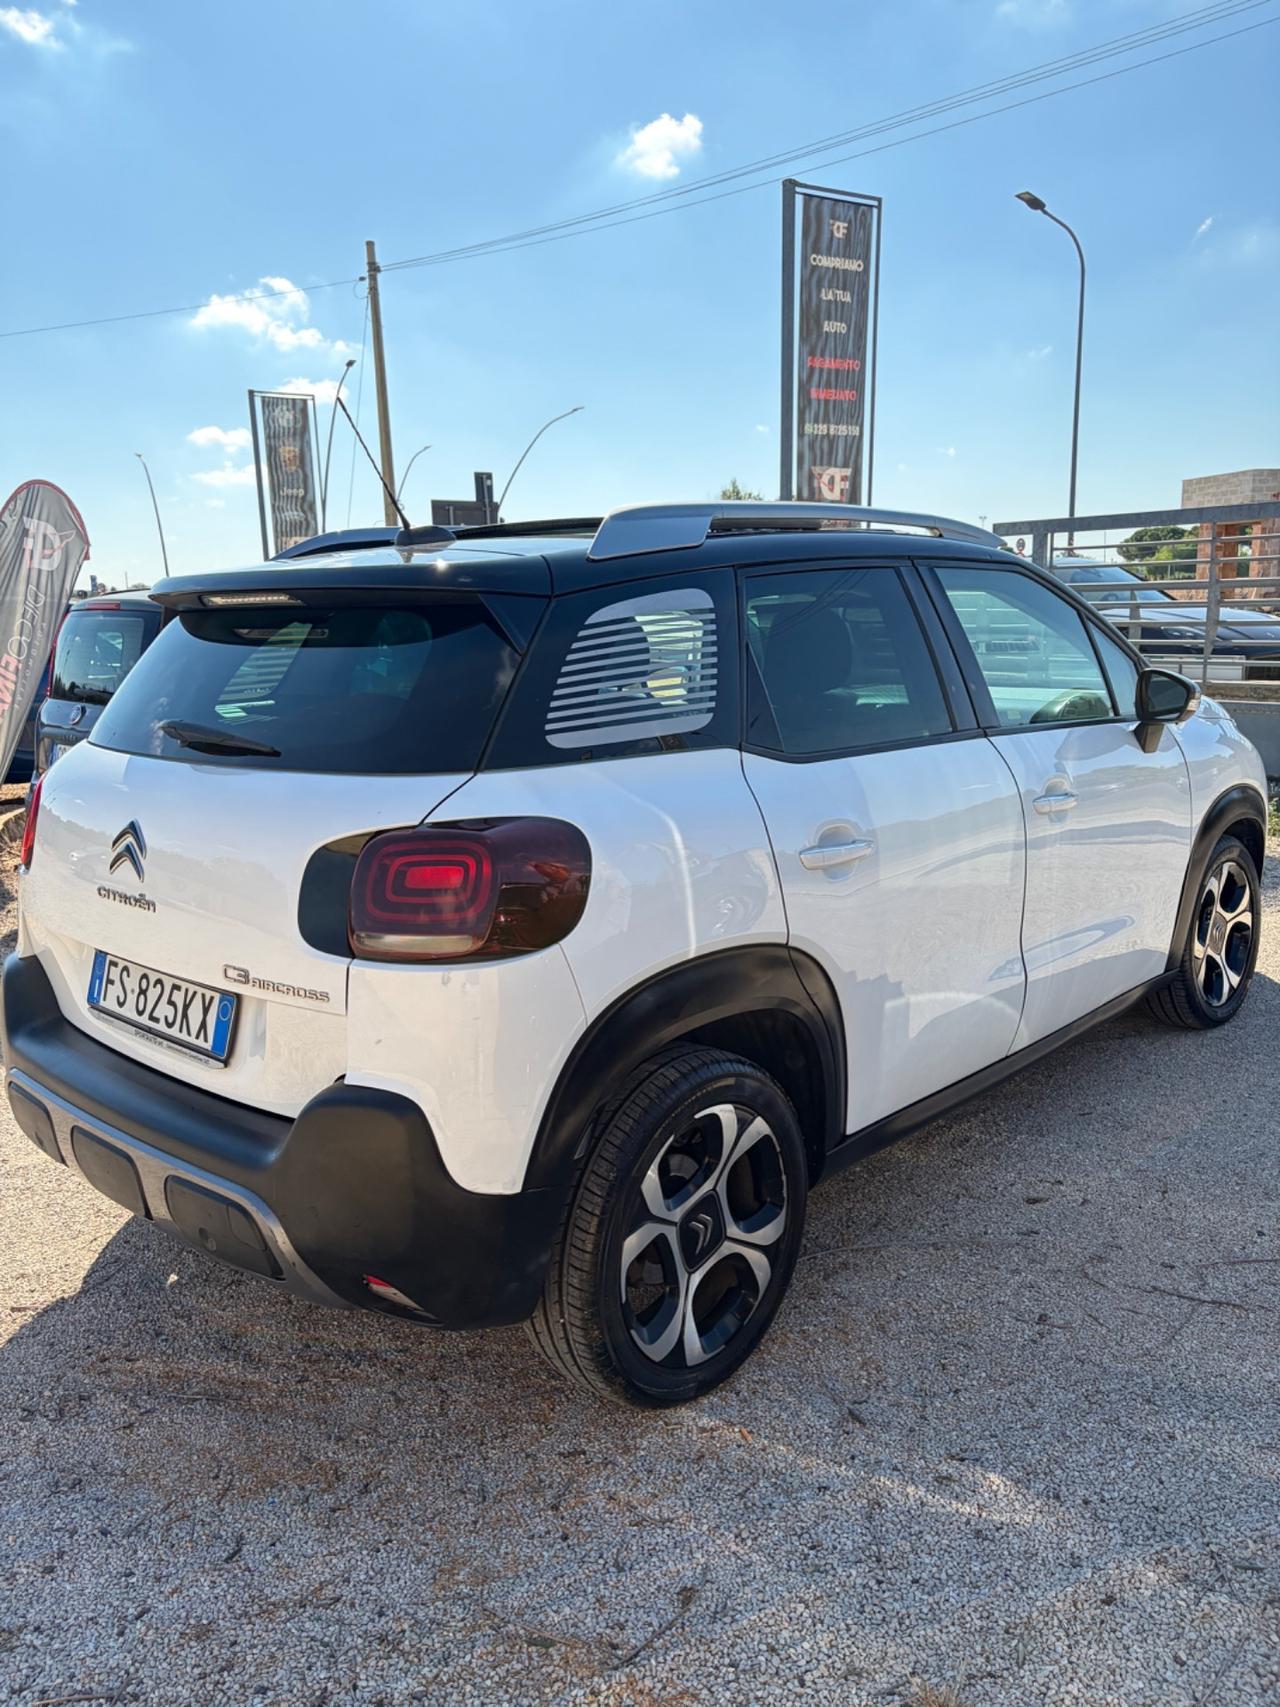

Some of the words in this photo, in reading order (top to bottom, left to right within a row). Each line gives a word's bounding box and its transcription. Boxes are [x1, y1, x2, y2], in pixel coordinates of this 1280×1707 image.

[810, 254, 864, 272] COMPRIAMO
[821, 288, 834, 301] LA
[835, 290, 852, 303] TUA
[823, 321, 847, 334] AUTO
[807, 356, 861, 371] PAGAMENTO
[809, 387, 857, 401] IMMEDIATO
[280, 487, 305, 496] Jeep
[97, 885, 156, 913] CITROËN
[223, 963, 250, 985] C3
[252, 977, 331, 1003] AIRCROSS
